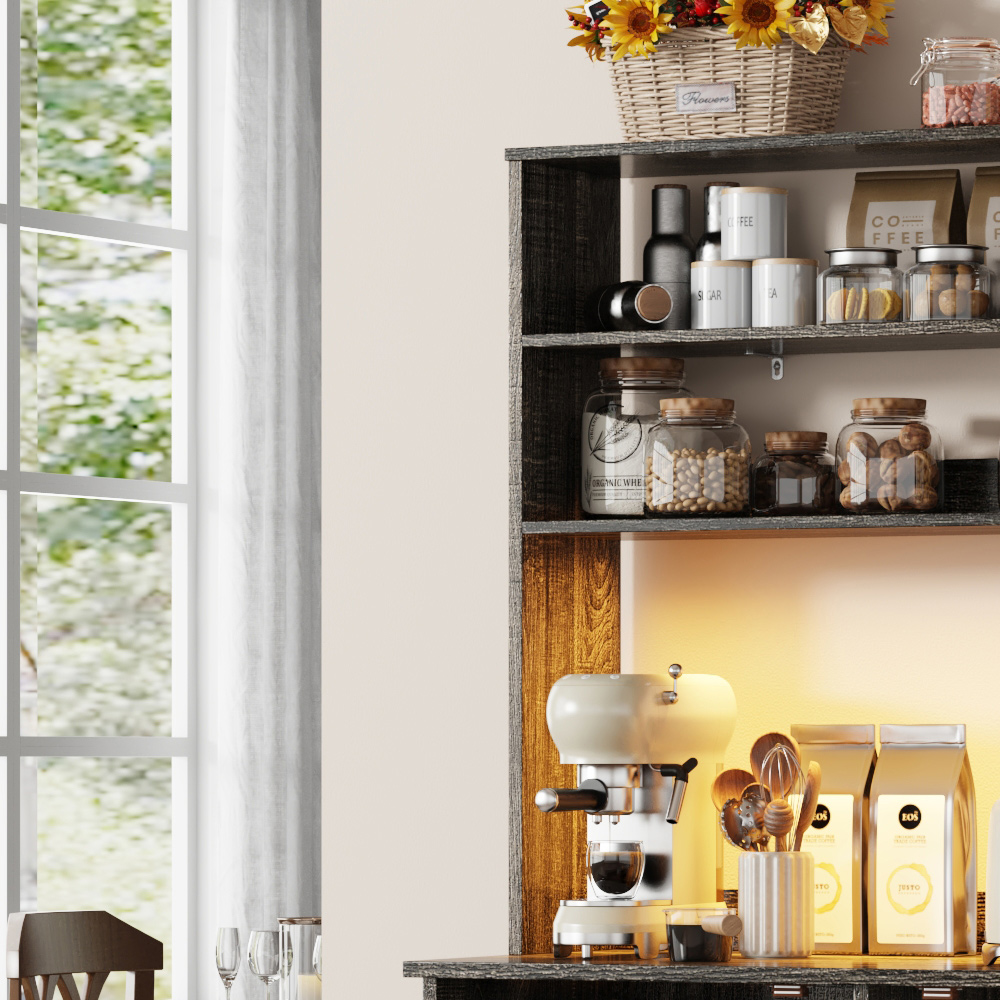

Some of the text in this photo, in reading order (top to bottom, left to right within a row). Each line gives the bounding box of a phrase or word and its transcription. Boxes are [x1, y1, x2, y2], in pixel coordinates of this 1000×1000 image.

[682, 91, 730, 106] Flowers
[764, 288, 778, 299] EA
[592, 478, 622, 488] ORGANIC
[898, 884, 921, 892] JUSTO
